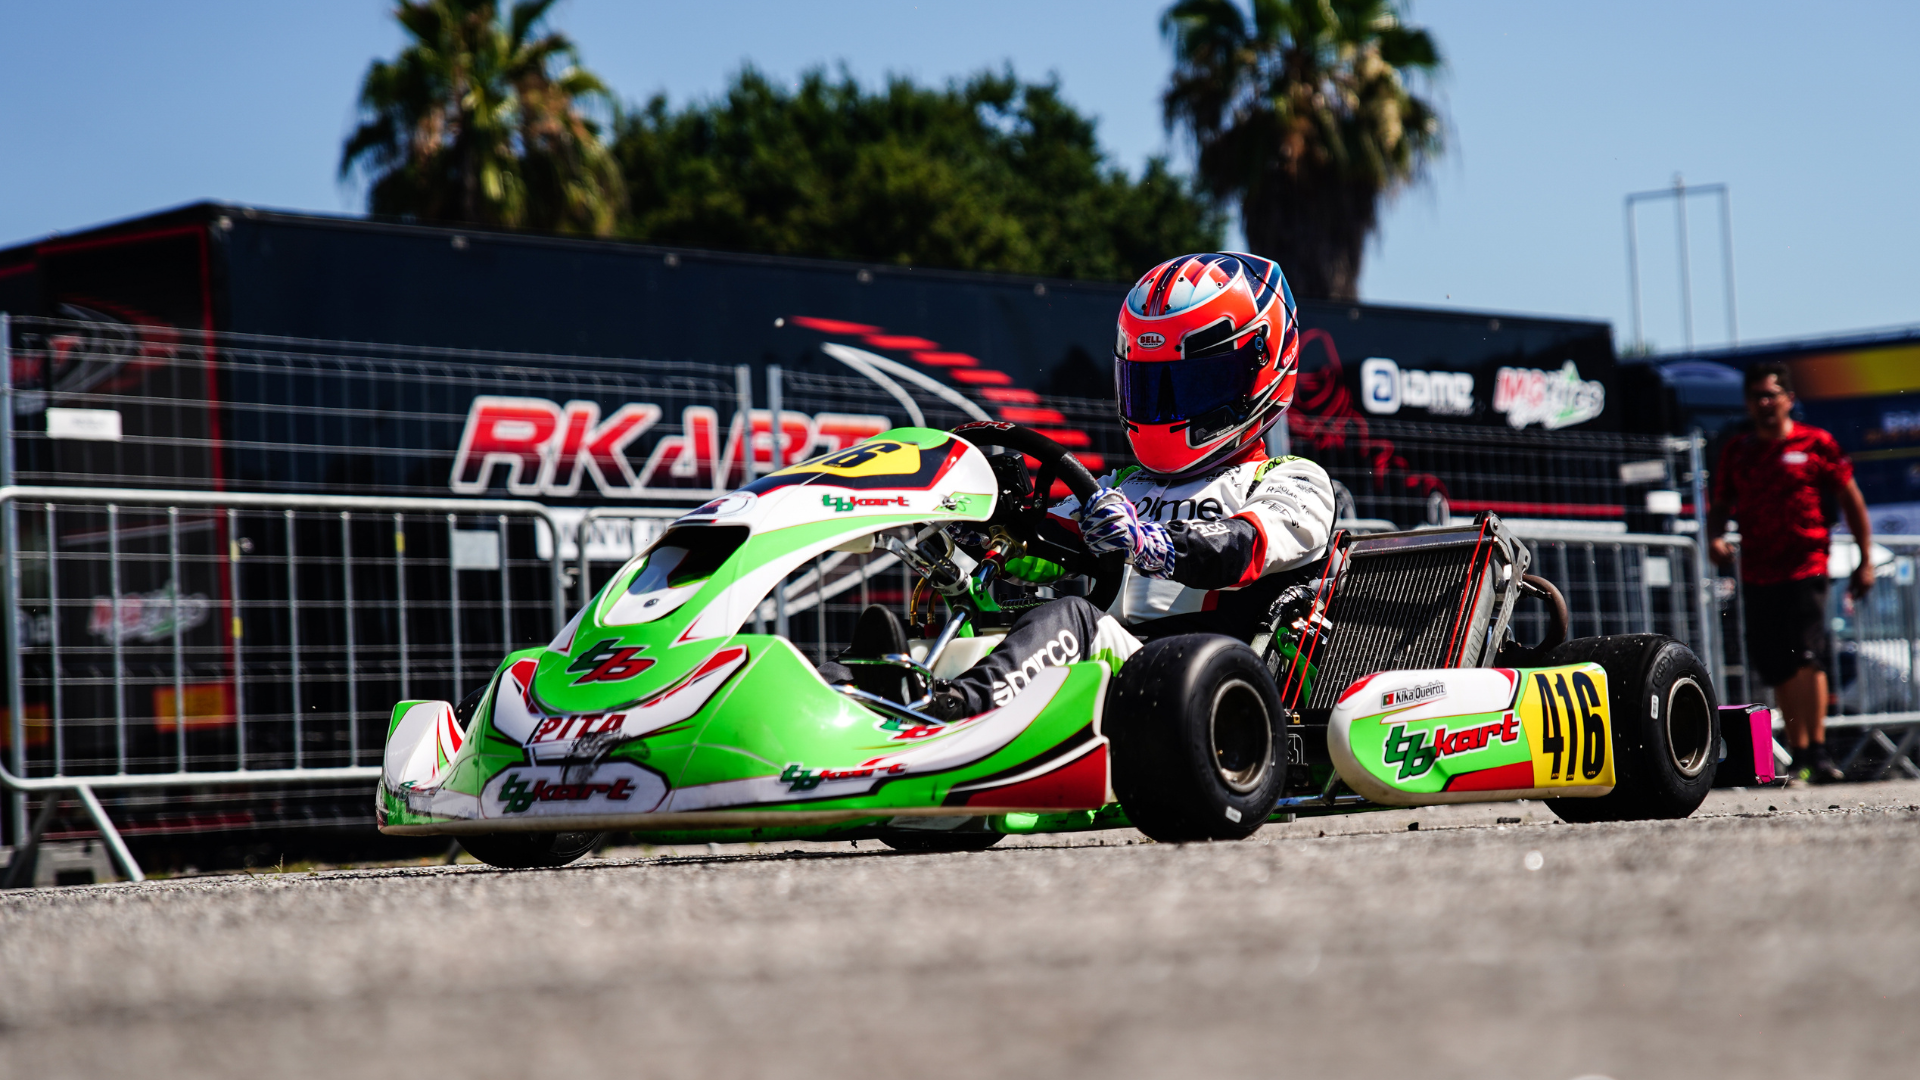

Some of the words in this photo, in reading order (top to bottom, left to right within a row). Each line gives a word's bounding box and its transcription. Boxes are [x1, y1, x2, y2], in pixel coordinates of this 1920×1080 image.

[1140, 335, 1161, 344] BELL
[450, 395, 891, 499] RKART
[822, 494, 910, 512] tbkart
[1396, 690, 1414, 703] Kika
[532, 714, 626, 743] PITA
[1534, 671, 1606, 782] 416
[1385, 714, 1519, 779] tbkart
[780, 762, 907, 792] tbkart
[499, 774, 635, 813] tbkart
